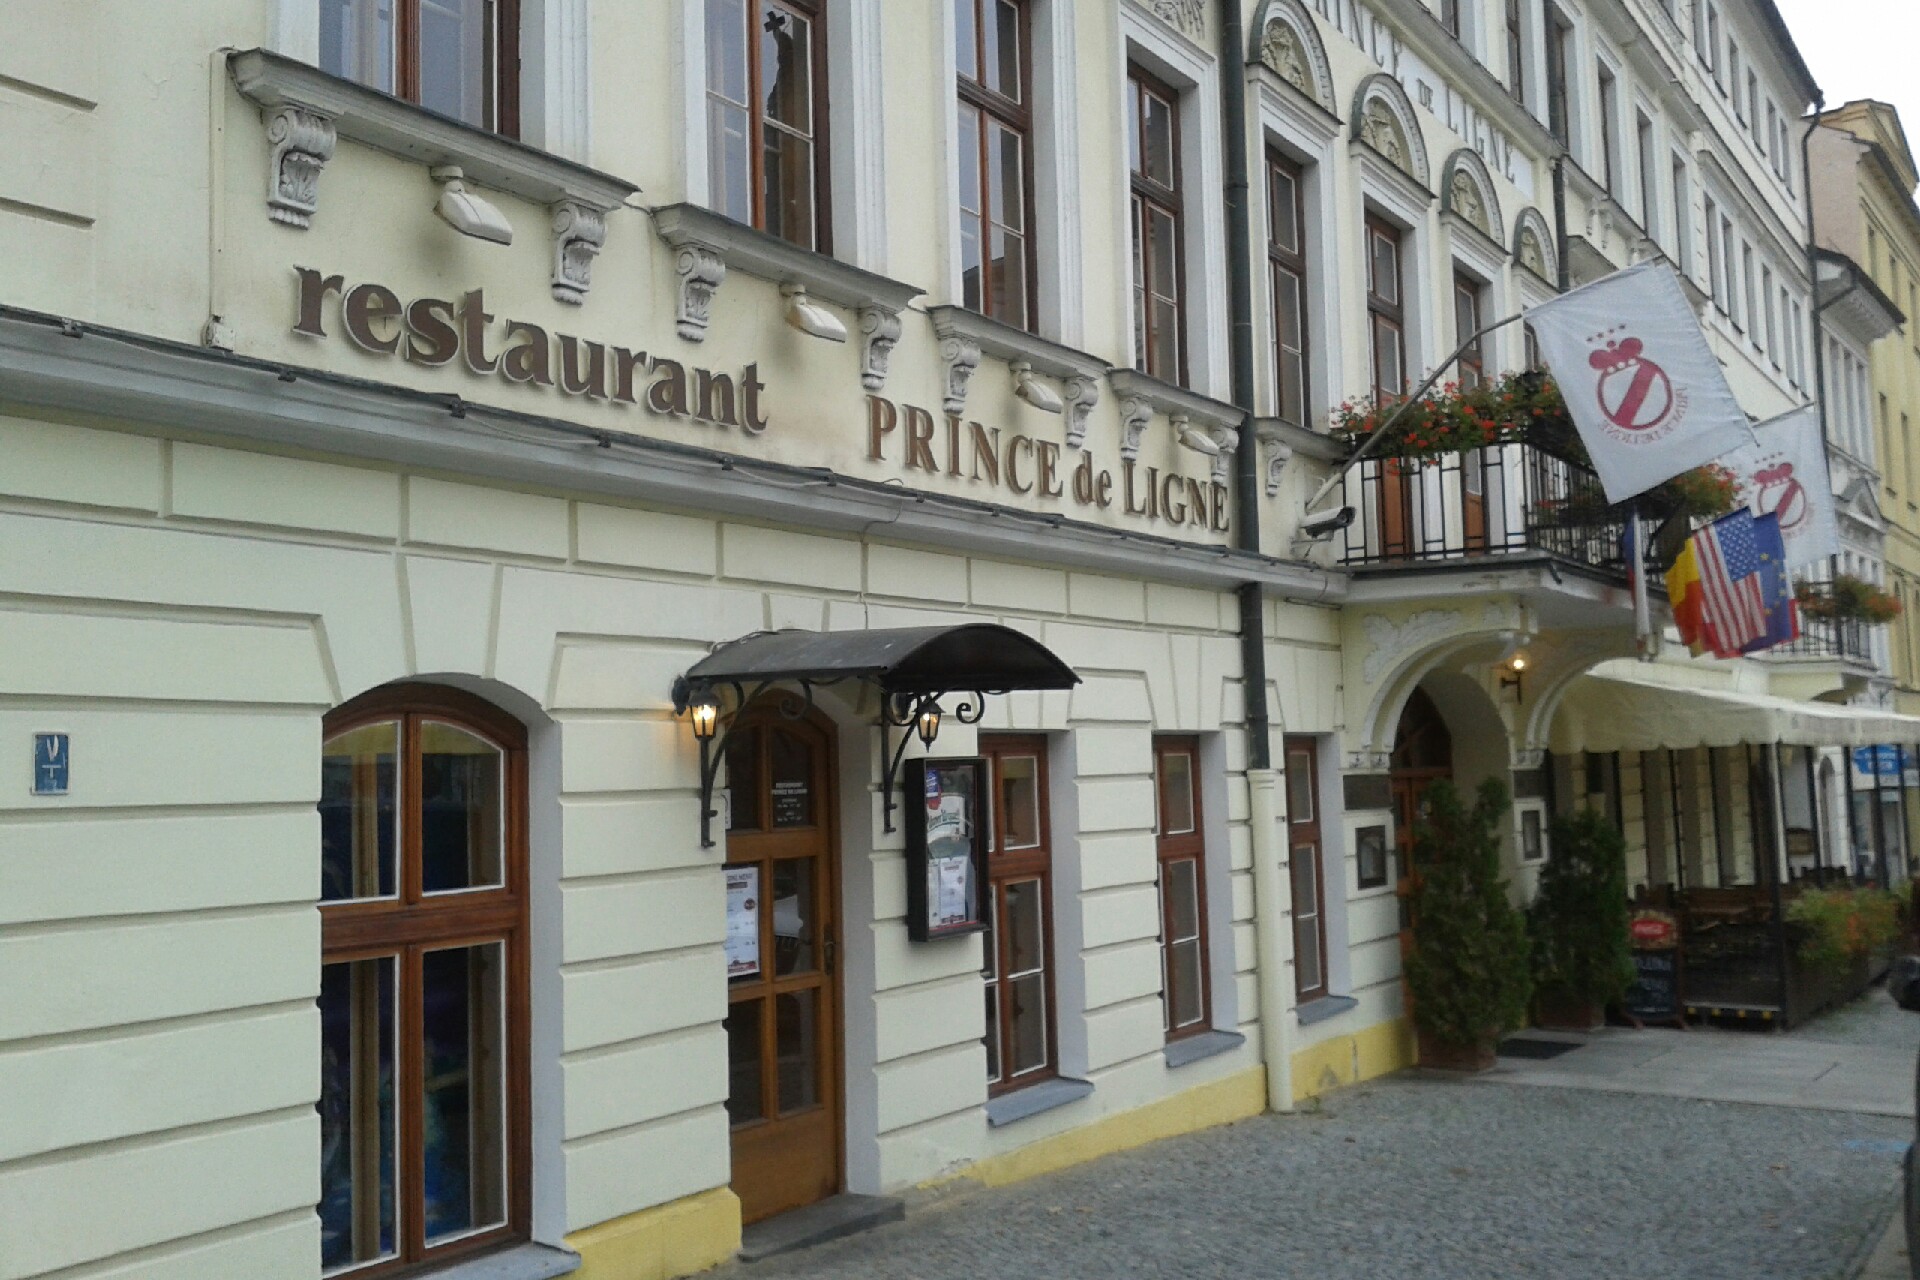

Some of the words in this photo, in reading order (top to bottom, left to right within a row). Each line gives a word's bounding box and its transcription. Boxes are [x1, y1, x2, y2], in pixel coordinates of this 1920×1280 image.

[1445, 82, 1516, 185] LIGNE
[290, 263, 769, 434] restaurant
[865, 394, 1064, 498] PRINCE
[1073, 450, 1112, 507] de
[1122, 458, 1230, 533] LIGNE
